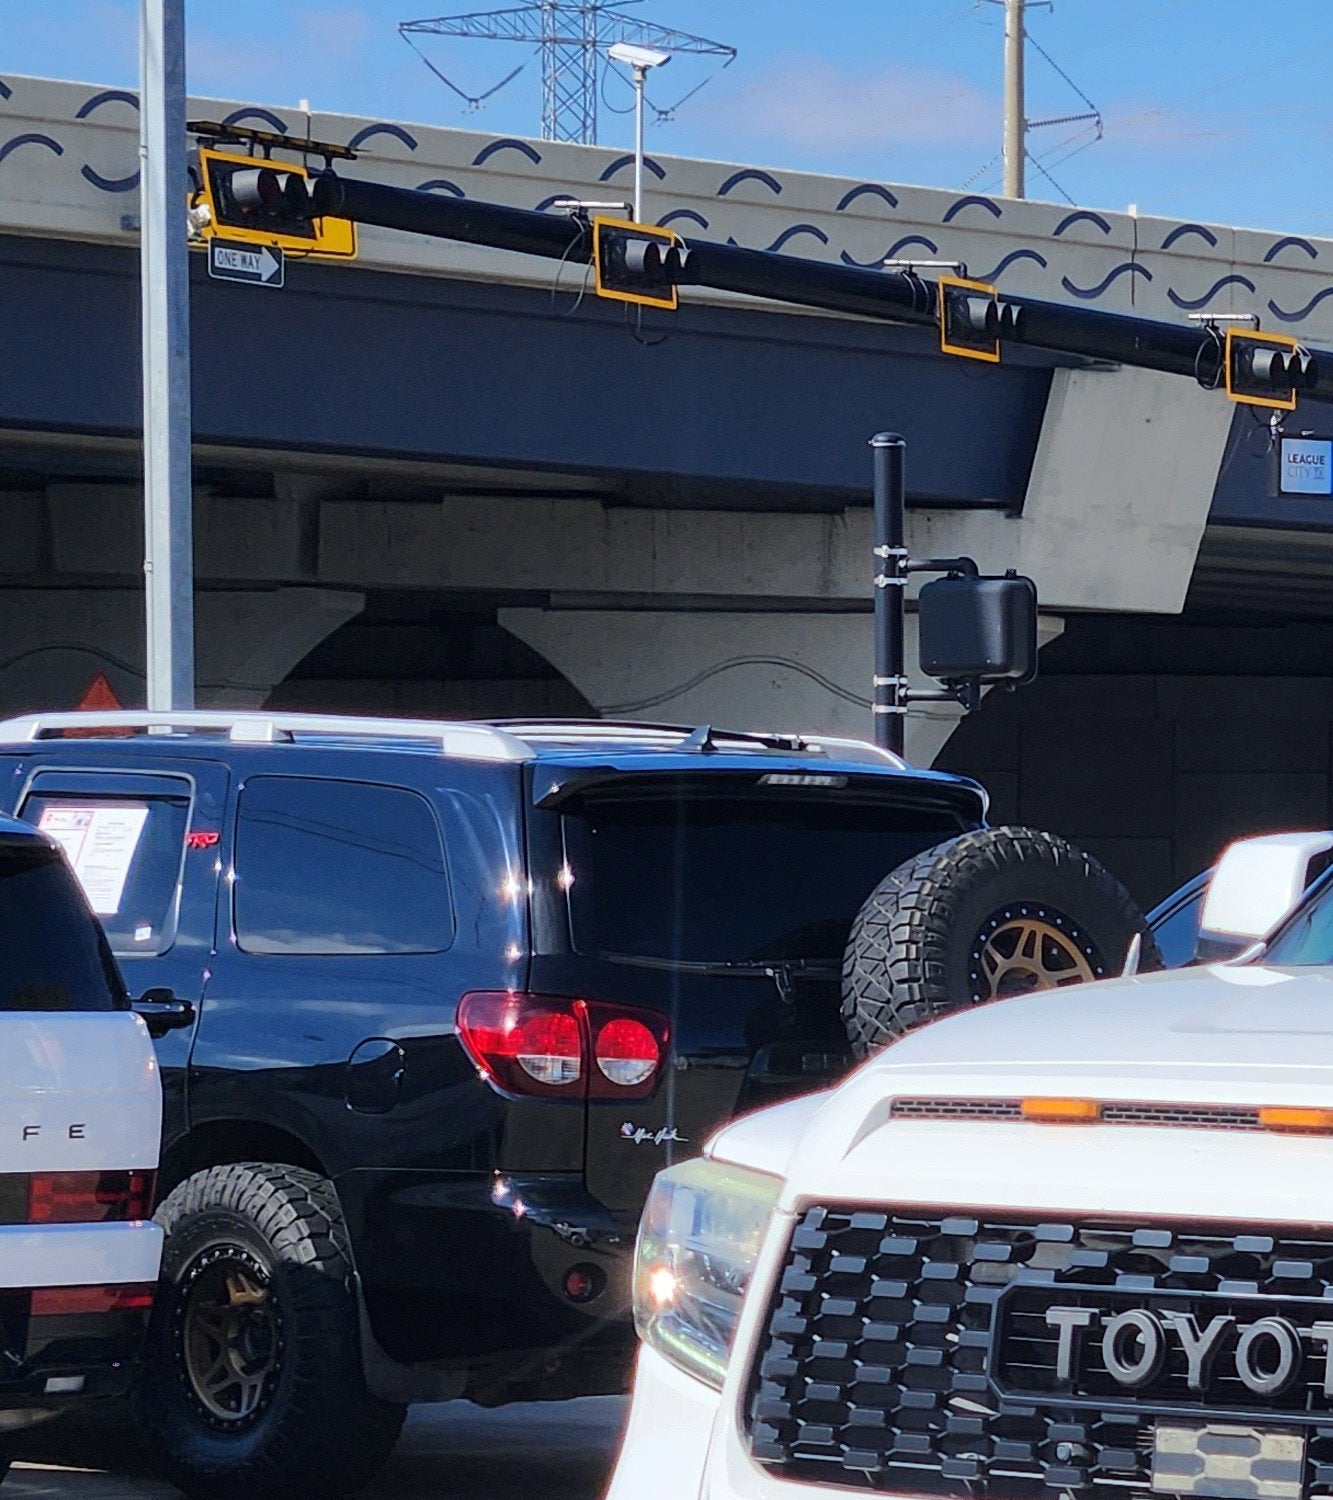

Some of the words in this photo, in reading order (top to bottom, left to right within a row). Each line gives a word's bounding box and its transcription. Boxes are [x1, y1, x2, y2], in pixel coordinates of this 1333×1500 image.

[216, 249, 237, 267] ONE
[240, 254, 261, 270] WAY
[1287, 453, 1326, 466] LEAGUE
[1286, 465, 1311, 479] CITY
